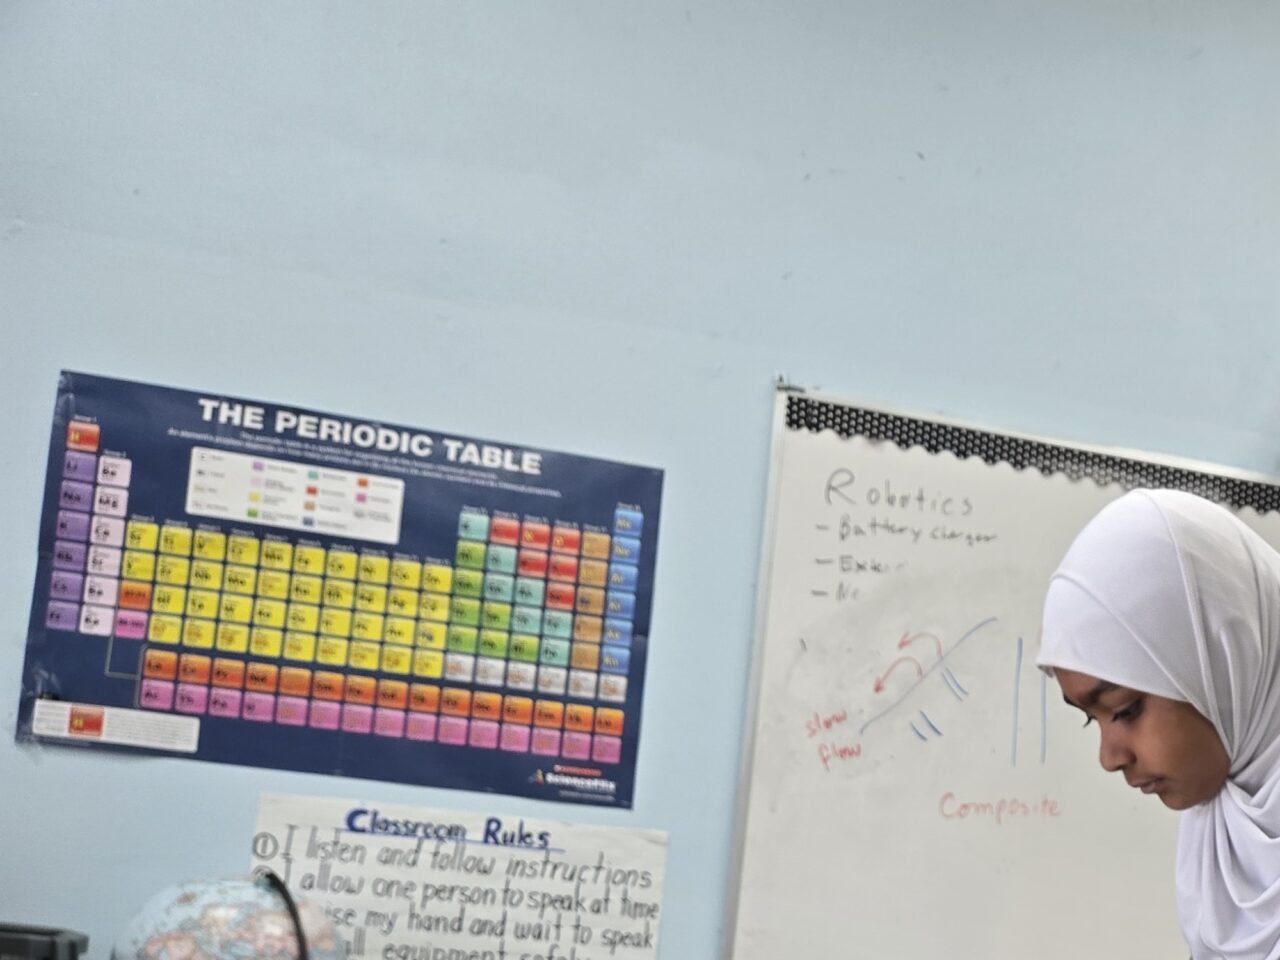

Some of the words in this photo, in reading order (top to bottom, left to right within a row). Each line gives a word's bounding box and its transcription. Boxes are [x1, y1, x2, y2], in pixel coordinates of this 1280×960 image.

[198, 397, 265, 430] THE
[274, 410, 433, 457] PERIODIC
[442, 438, 543, 475] TABLE
[824, 468, 974, 516] Robotics
[306, 826, 367, 865] listen
[377, 837, 424, 869] and
[430, 838, 496, 876] follow
[504, 849, 654, 889] instructions
[346, 808, 467, 842] Classroom
[483, 816, 551, 848] Rules
[300, 860, 365, 895] allow
[373, 876, 418, 900] one
[421, 882, 498, 911] person
[500, 878, 526, 909] to
[527, 881, 588, 921] speak
[590, 883, 612, 914] at
[620, 886, 661, 921] time
[364, 910, 400, 937] my
[407, 900, 466, 934] hand
[468, 908, 508, 938] and
[513, 912, 564, 942] wait
[570, 914, 593, 946] to
[600, 919, 654, 957] speak
